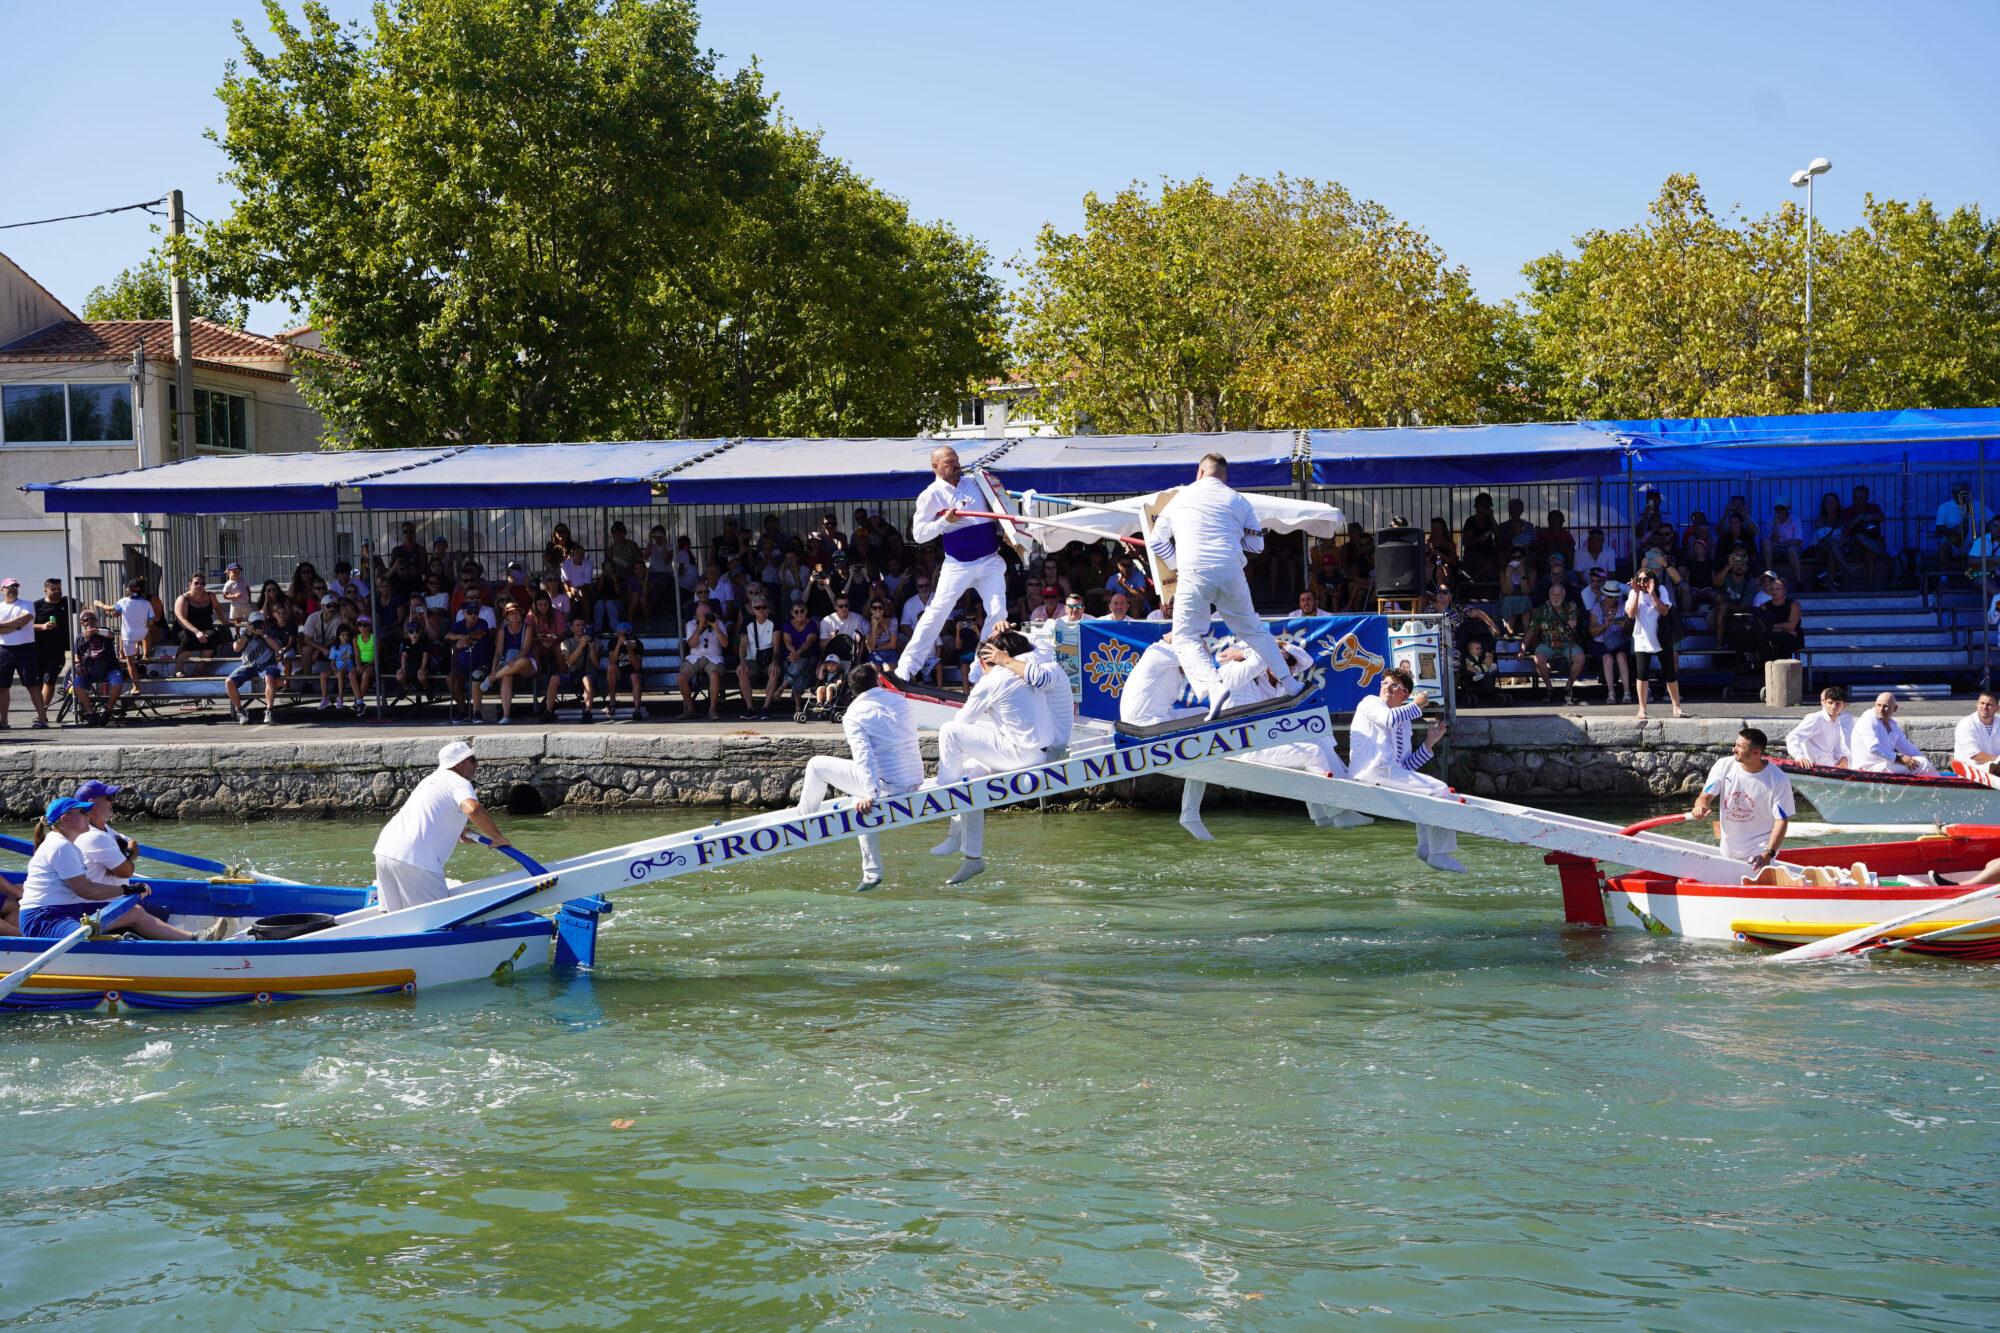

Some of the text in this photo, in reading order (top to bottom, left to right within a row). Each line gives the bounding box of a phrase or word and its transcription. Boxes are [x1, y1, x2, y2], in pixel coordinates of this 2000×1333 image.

[1096, 662, 1133, 674] ASVB
[695, 724, 1258, 866] FRONTIGNAN SON MUSCAT
